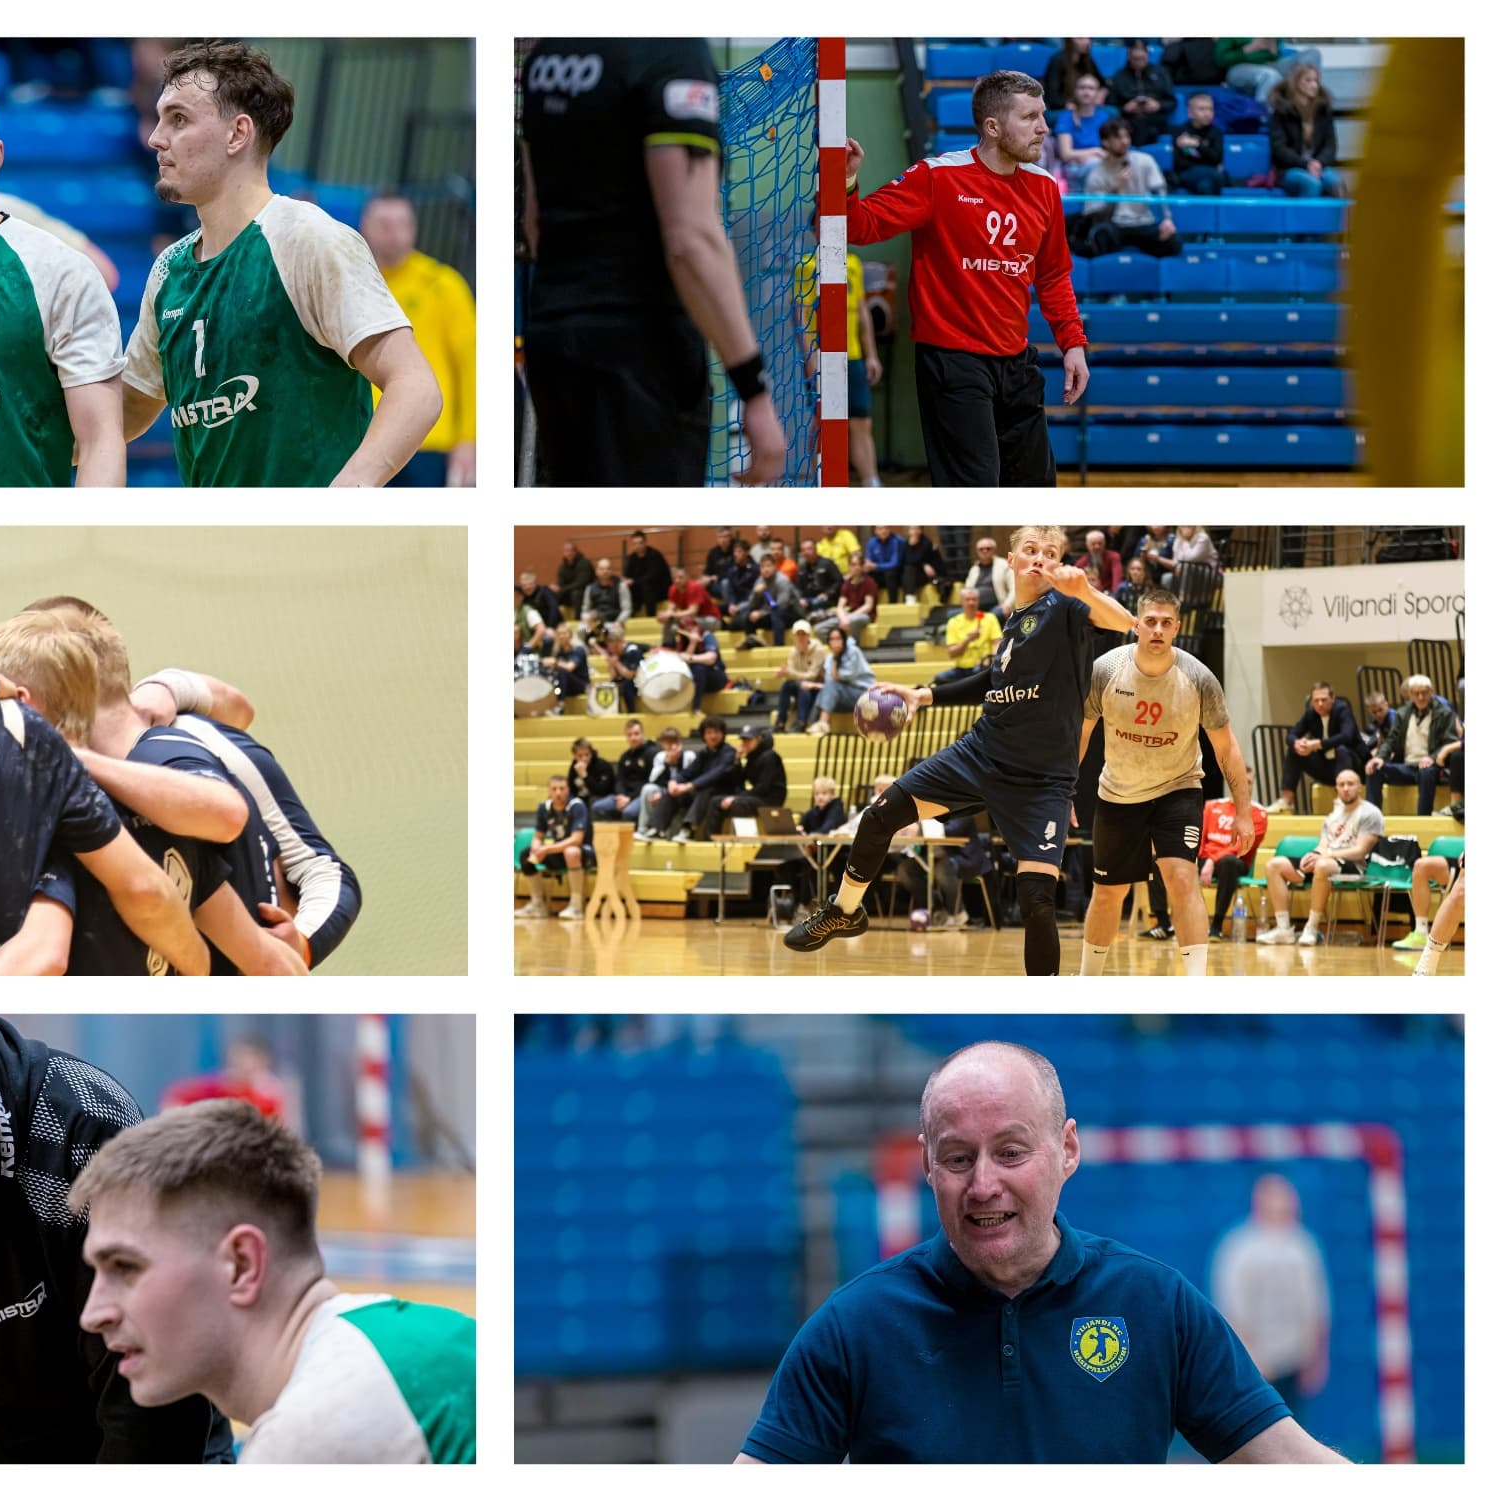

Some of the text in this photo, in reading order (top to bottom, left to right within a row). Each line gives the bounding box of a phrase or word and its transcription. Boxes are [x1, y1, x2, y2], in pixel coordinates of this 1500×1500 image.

[958, 194, 984, 205] Kempa
[986, 210, 1018, 246] 92
[962, 254, 1033, 275] MISTRA
[171, 382, 259, 427] MISTRA
[1323, 593, 1397, 622] Viljandi
[1134, 700, 1163, 726] 29
[1115, 728, 1179, 748] MISTRA
